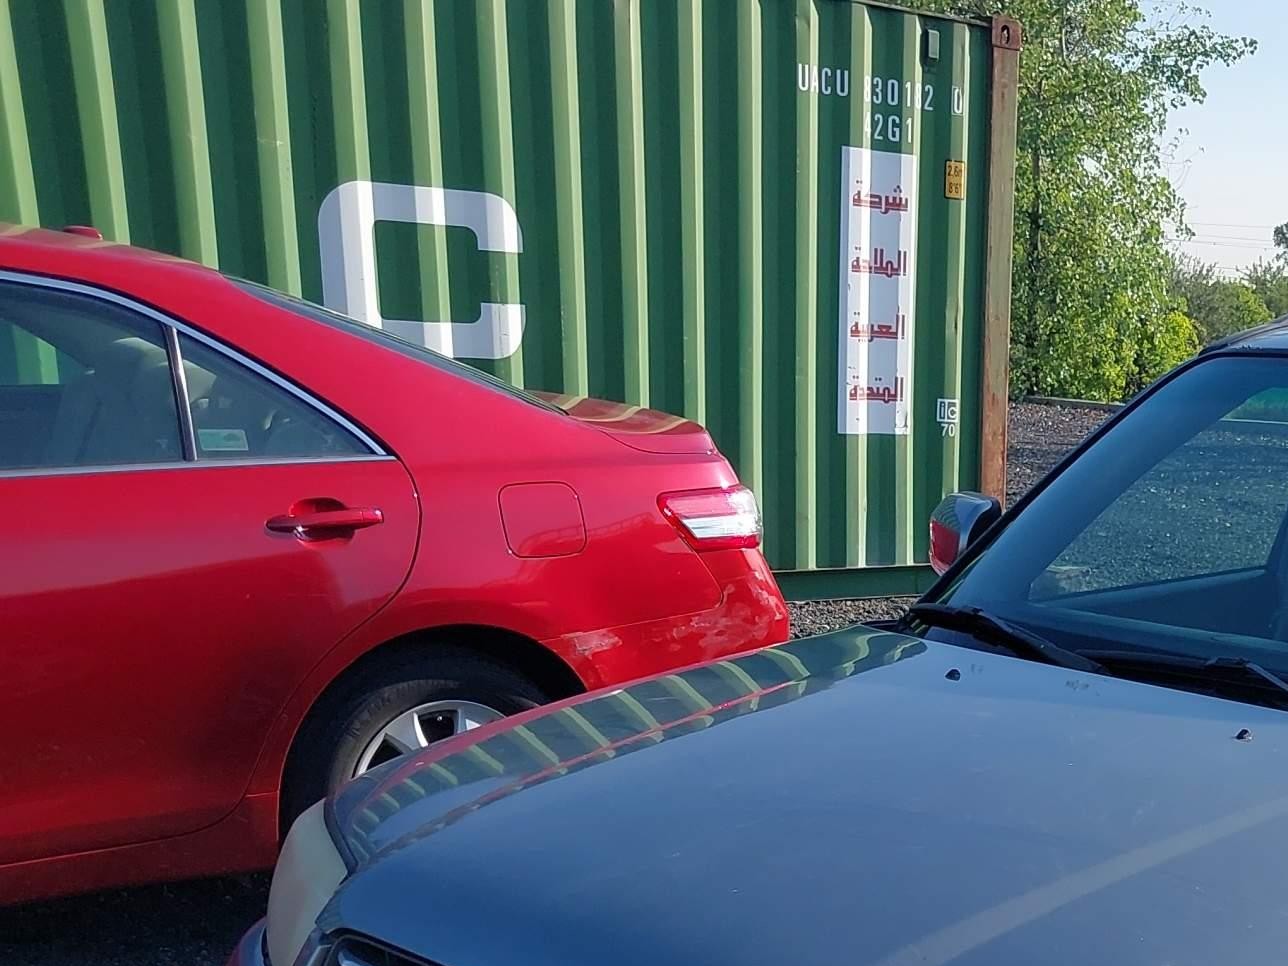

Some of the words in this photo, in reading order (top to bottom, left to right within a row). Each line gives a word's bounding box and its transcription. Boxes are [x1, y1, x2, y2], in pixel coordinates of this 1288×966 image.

[798, 63, 849, 97] UACU
[863, 75, 934, 111] 830182
[863, 111, 913, 144] 42G1
[852, 180, 908, 215] شركة
[318, 181, 526, 359] C
[851, 246, 907, 278] الملاحة
[850, 311, 905, 342] العربية
[849, 375, 904, 404] المتحدة
[941, 423, 955, 437] 70
